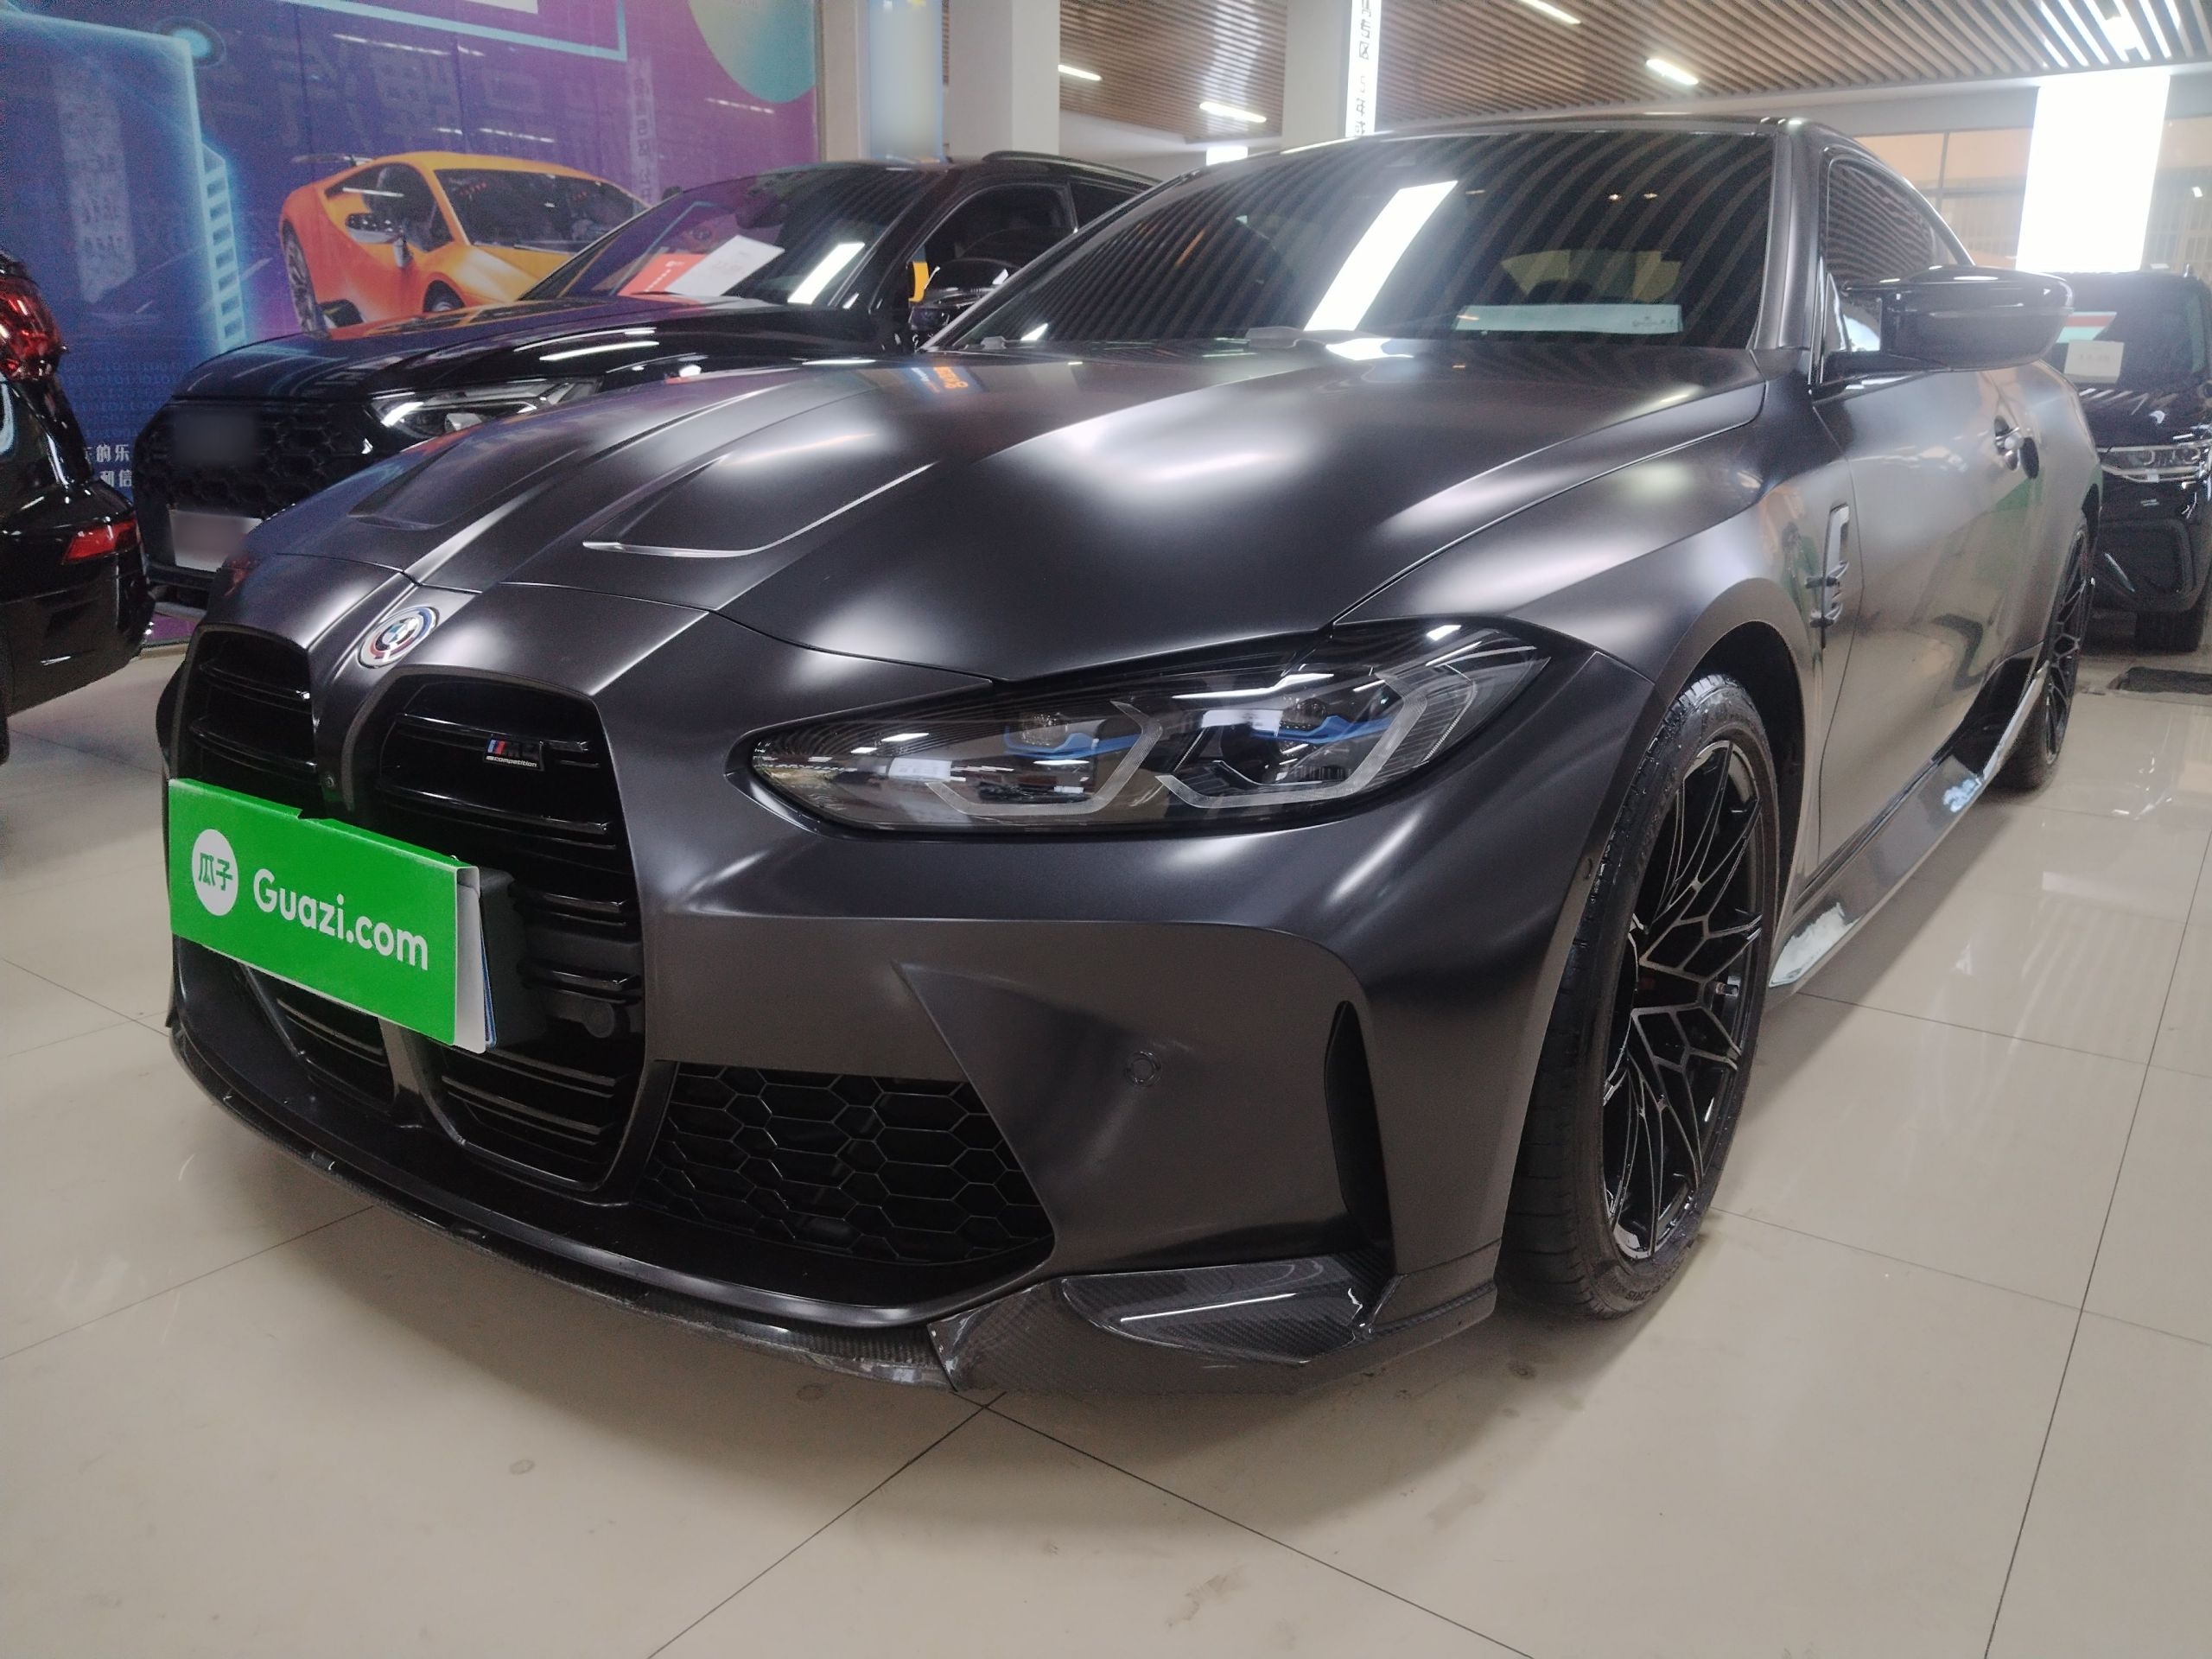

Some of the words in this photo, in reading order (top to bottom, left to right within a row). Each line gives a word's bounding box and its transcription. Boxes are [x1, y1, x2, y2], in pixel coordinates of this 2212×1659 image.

[86, 442, 130, 462] 的乐
[494, 757, 537, 767] competition
[199, 852, 233, 892] 瓜子
[253, 868, 429, 971] Guazi.com
